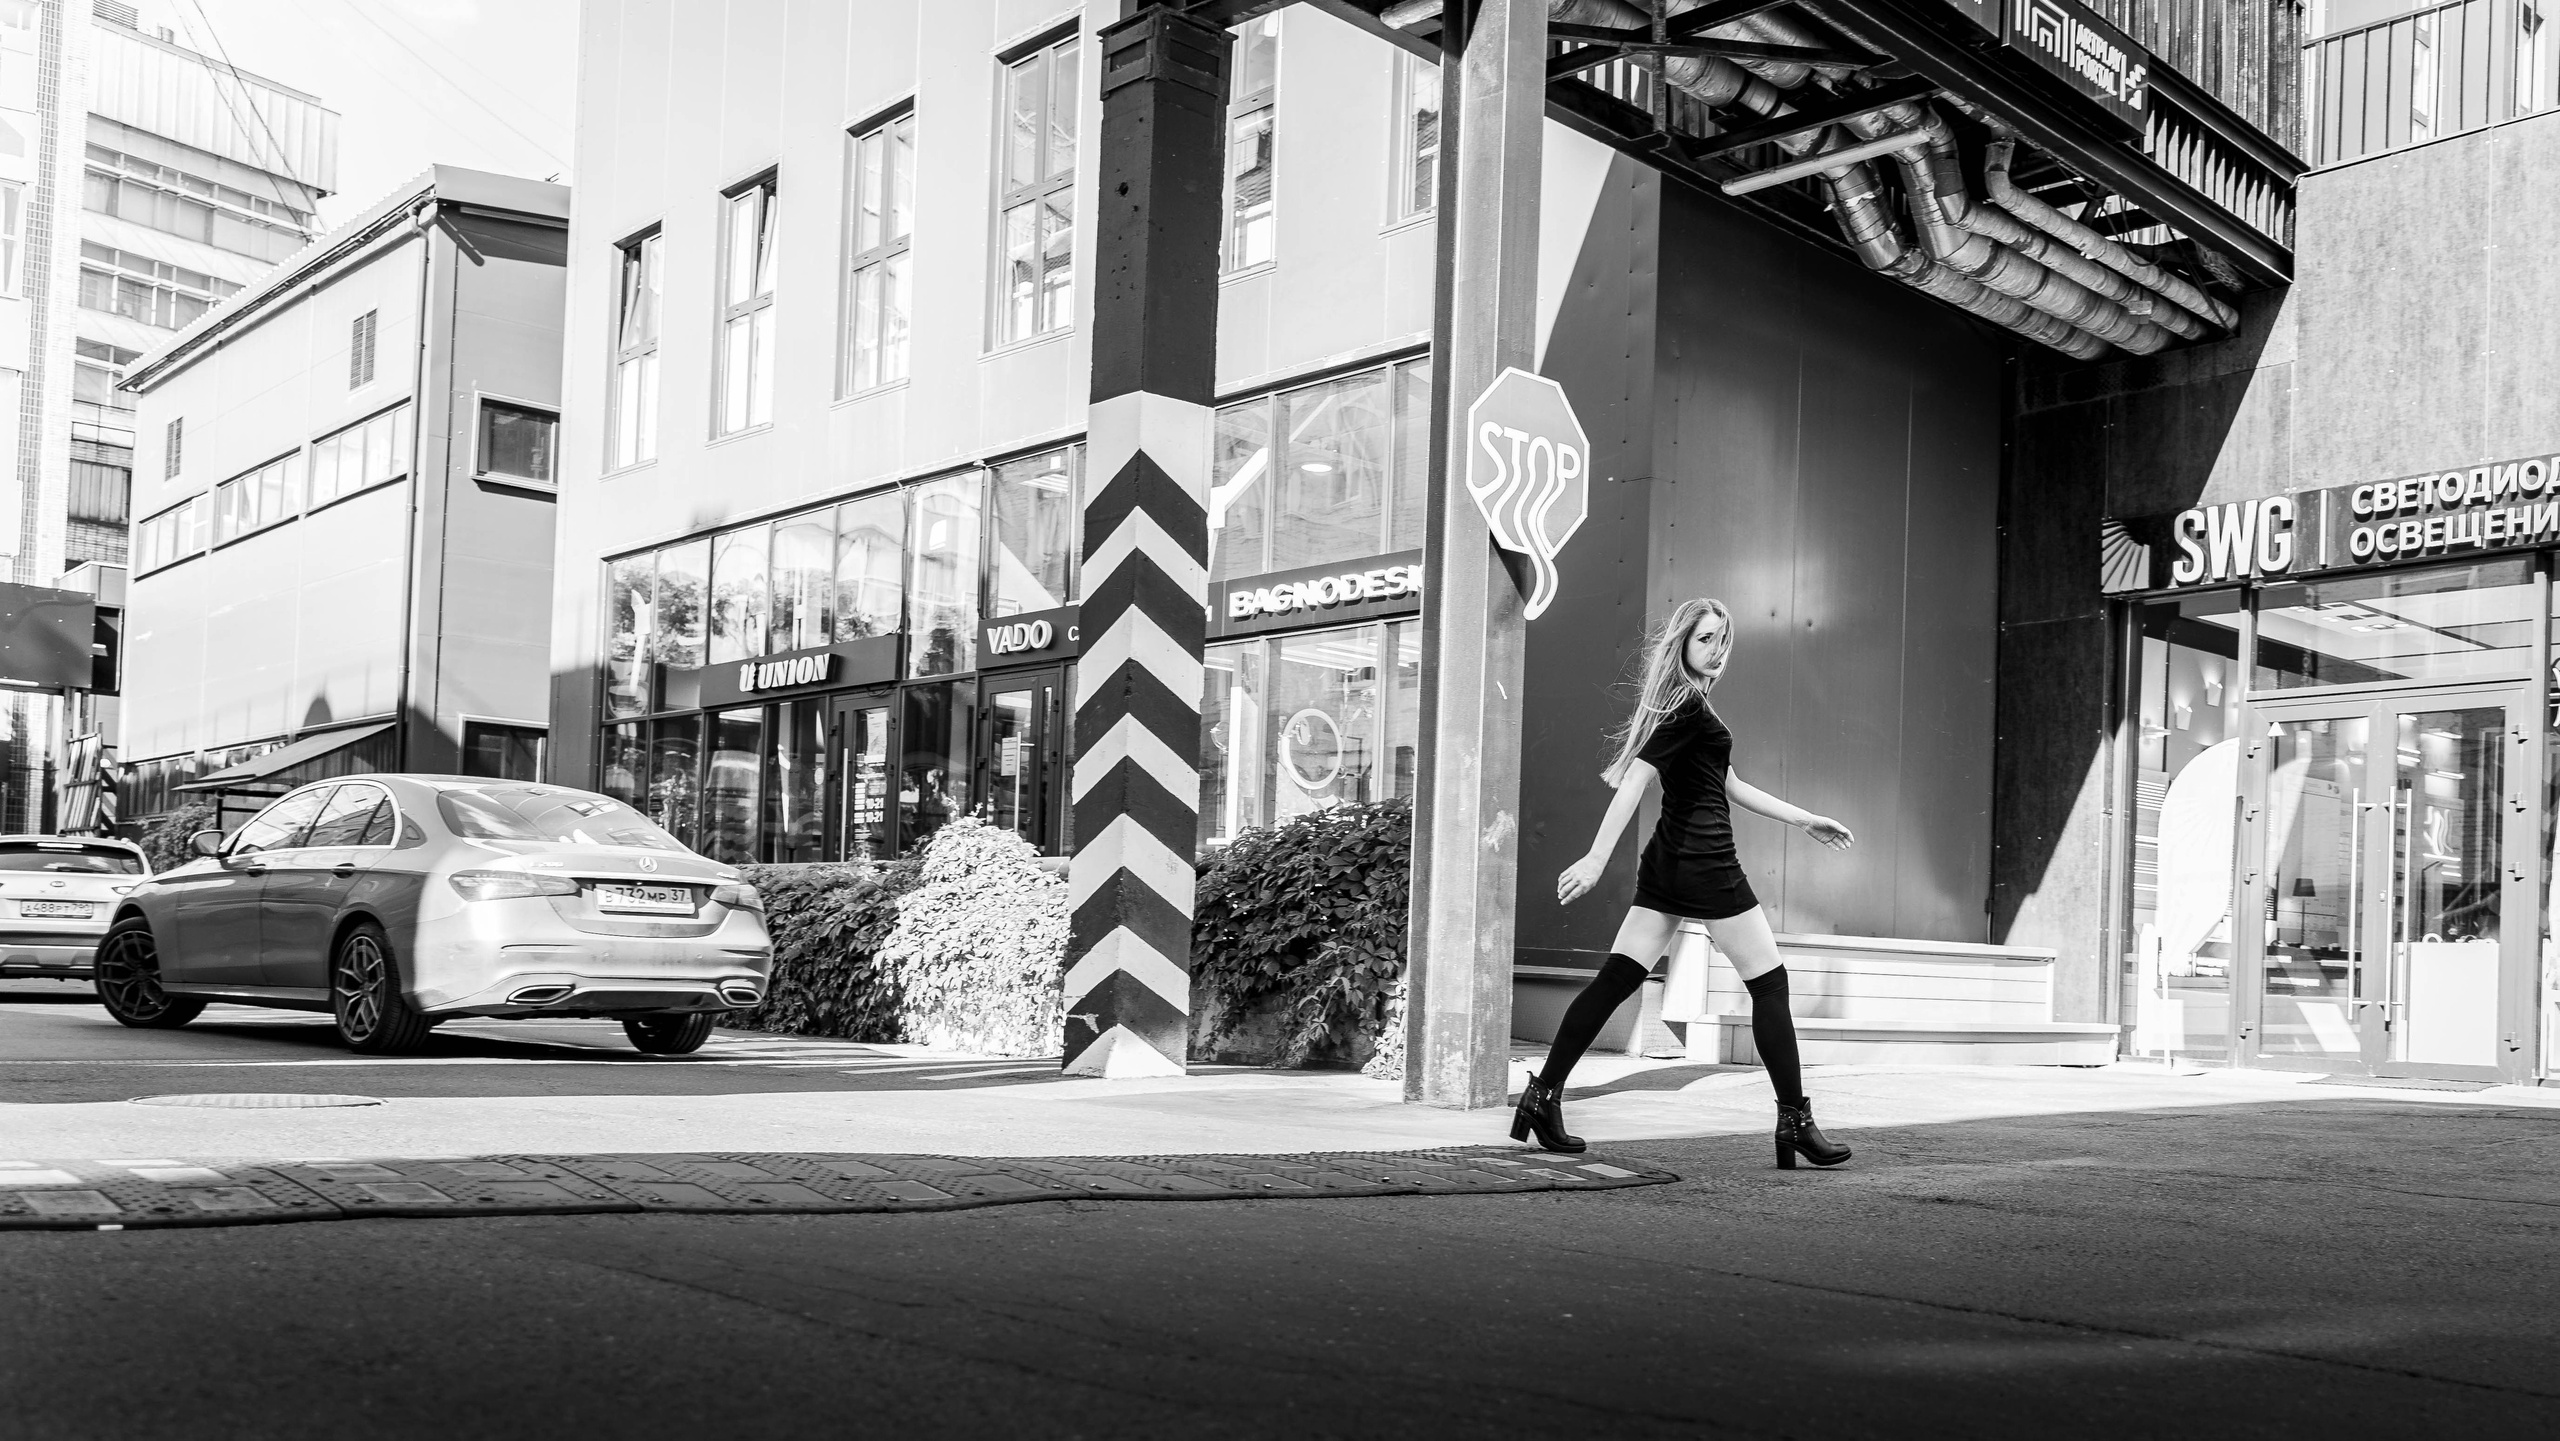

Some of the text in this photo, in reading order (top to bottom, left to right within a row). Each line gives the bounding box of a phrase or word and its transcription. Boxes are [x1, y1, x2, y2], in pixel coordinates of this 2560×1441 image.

[2075, 49, 2118, 96] PORTAL
[1479, 421, 1581, 551] STOP
[2173, 496, 2293, 583] SWG
[2350, 501, 2560, 557] ОСВЕЩЕНИ
[987, 619, 1053, 655] VADO
[757, 653, 830, 690] UNION
